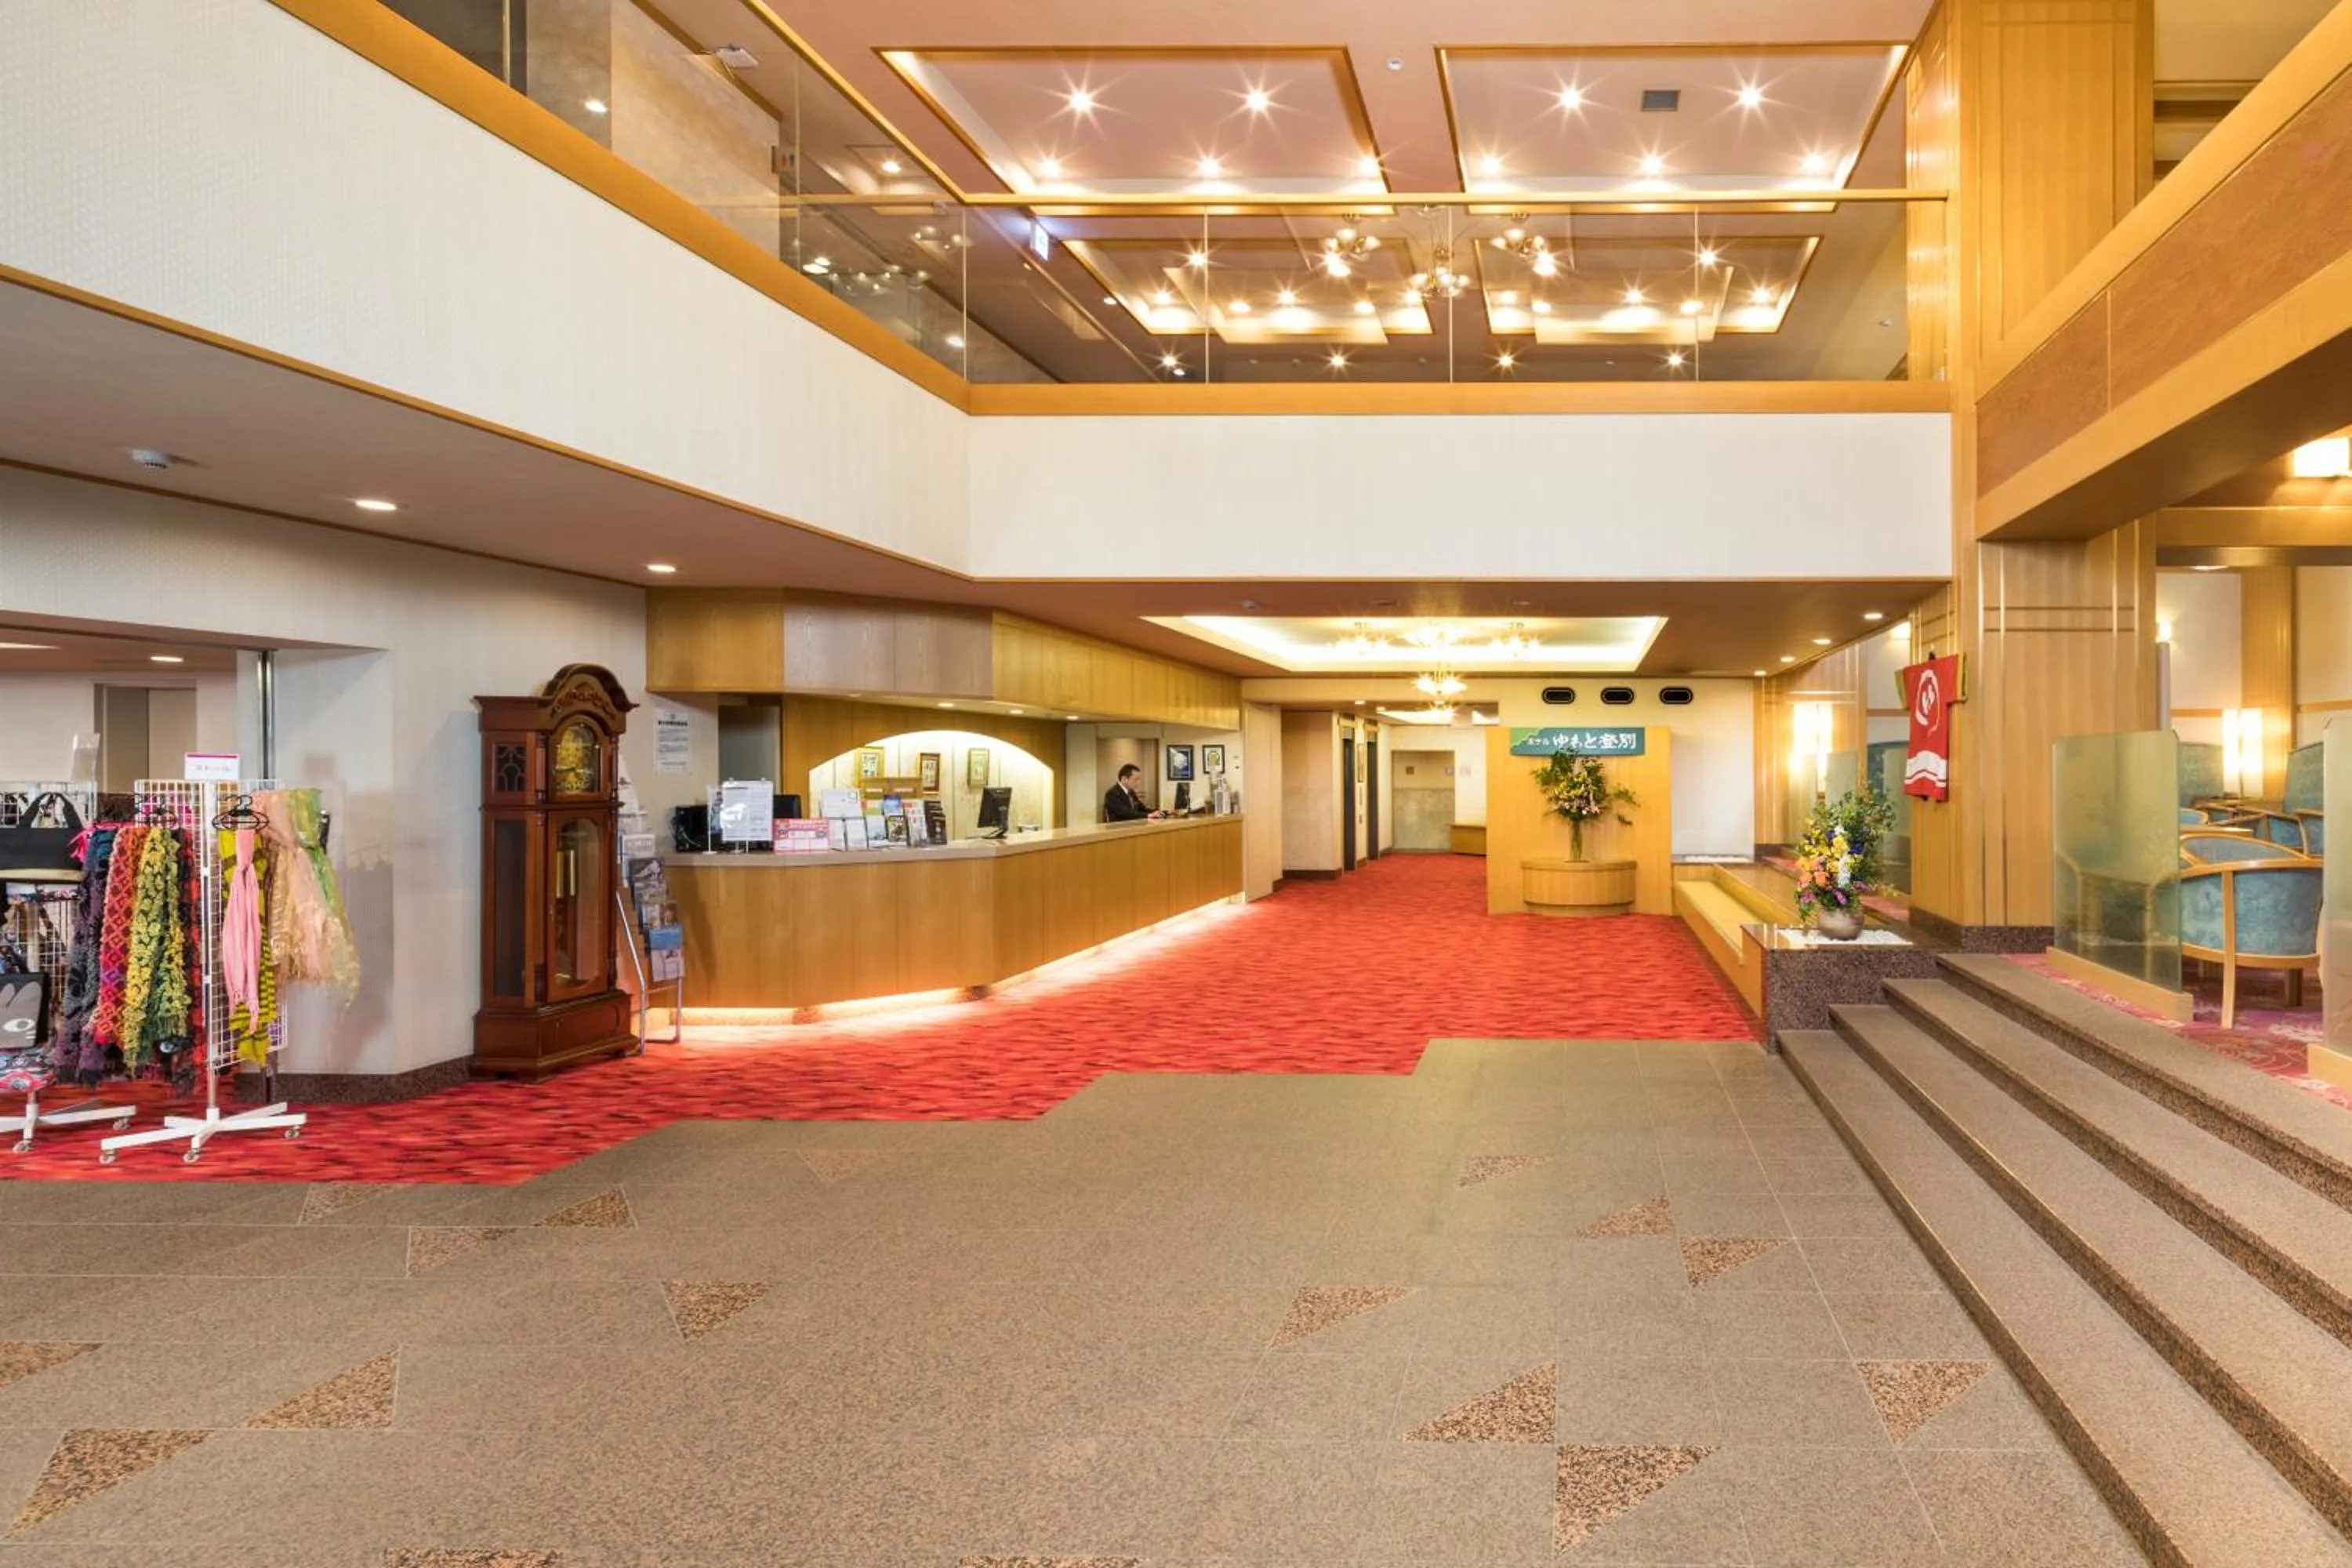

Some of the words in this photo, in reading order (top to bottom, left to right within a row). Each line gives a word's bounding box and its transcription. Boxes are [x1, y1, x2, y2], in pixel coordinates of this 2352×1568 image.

[1552, 733, 1636, 749] ゆもと登別
